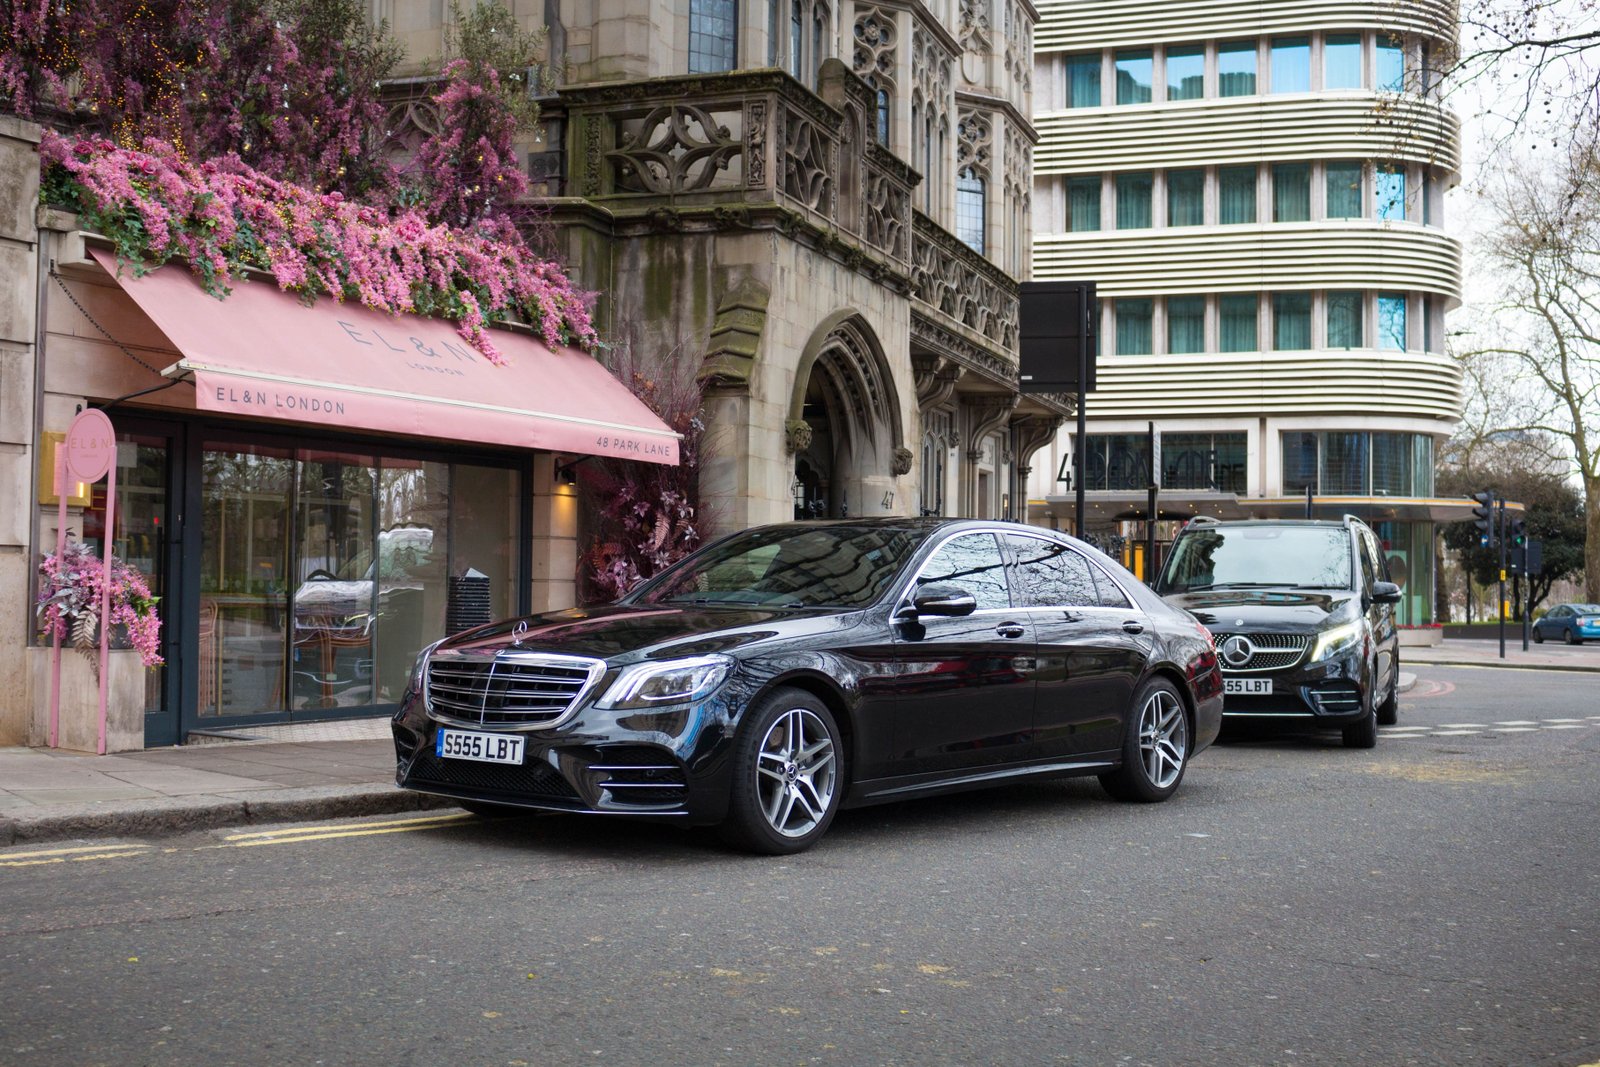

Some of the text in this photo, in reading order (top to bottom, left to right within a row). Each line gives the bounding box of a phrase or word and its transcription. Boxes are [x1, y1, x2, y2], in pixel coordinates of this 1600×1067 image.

[337, 320, 477, 363] EL&N
[406, 362, 465, 376] LONDON
[216, 387, 345, 414] EL&N LONDON
[71, 437, 109, 449] EL&N
[596, 437, 670, 456] 48 PARK LANE
[1223, 680, 1270, 692] 55 LBT
[444, 733, 520, 760] S555 LBT
